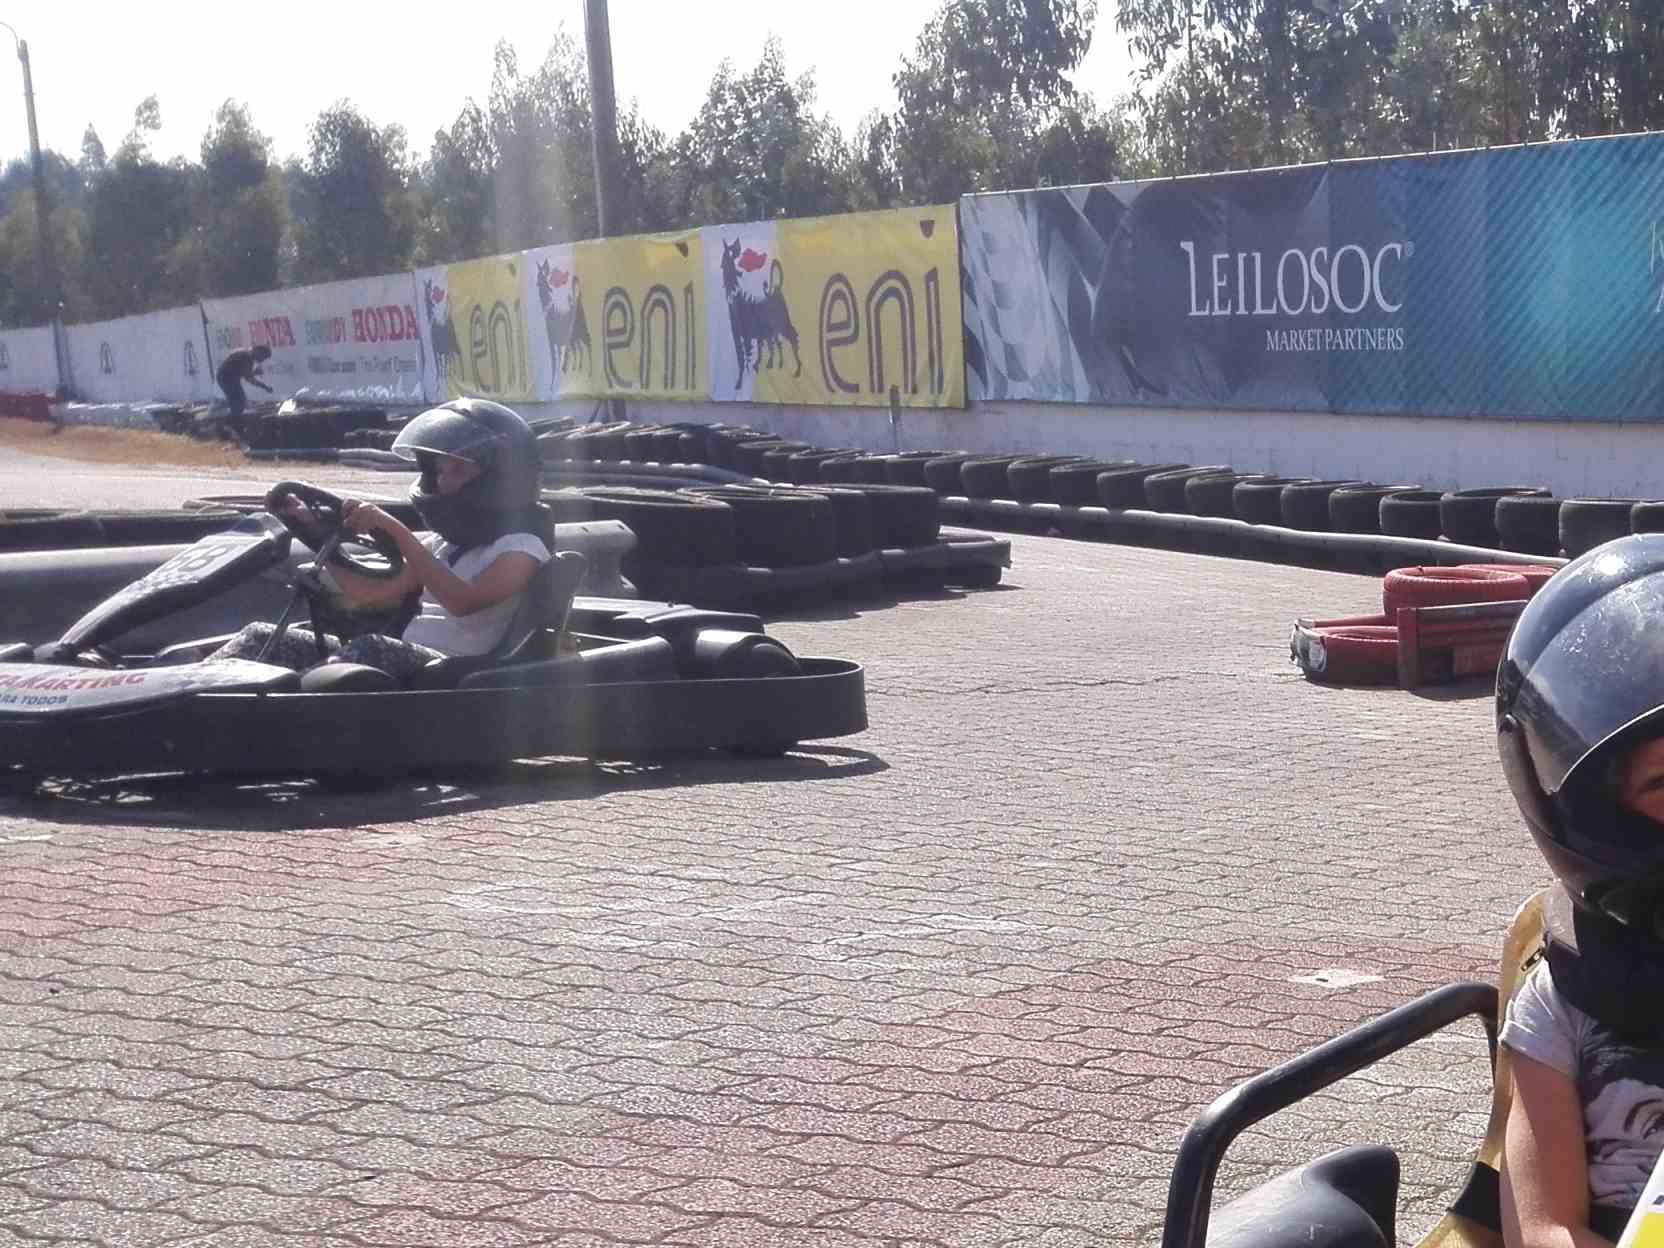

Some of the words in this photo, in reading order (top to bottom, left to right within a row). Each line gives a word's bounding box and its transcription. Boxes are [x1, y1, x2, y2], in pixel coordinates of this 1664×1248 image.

[470, 275, 527, 393] eni
[602, 252, 696, 390] eni
[819, 228, 945, 394] eni
[1180, 241, 1403, 316] LEILOSOC
